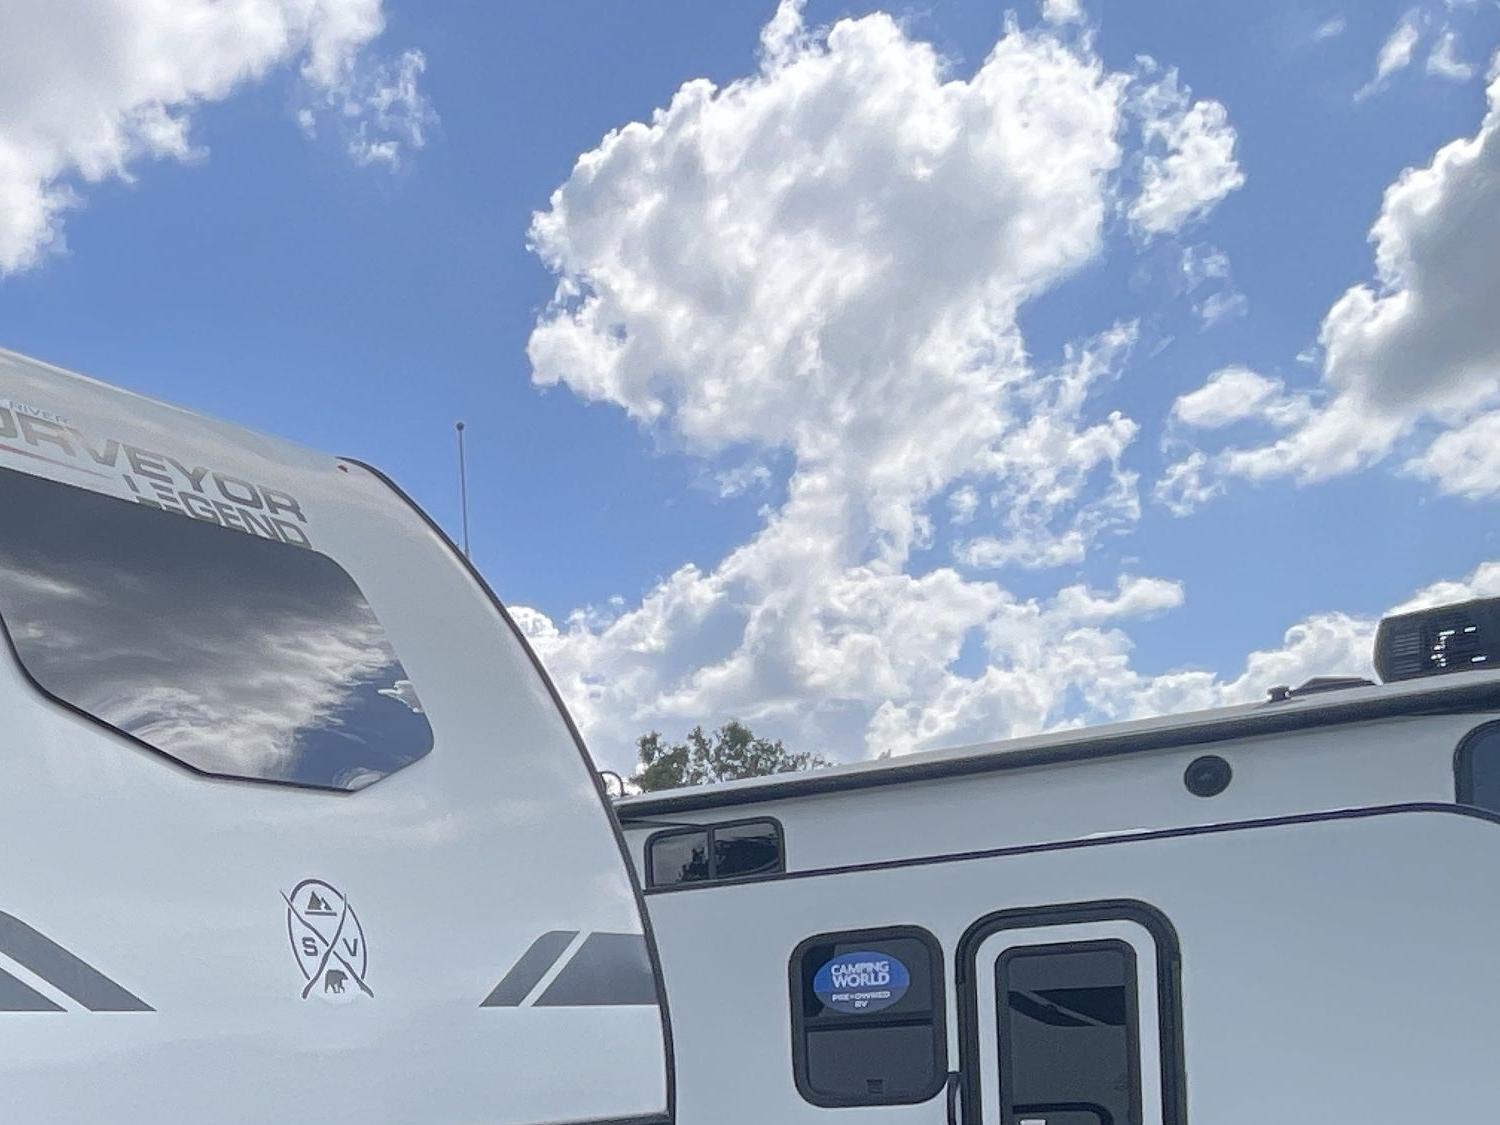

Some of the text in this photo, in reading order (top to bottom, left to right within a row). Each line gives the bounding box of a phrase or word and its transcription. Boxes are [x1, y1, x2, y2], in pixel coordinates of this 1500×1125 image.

[122, 474, 312, 550] LEGEND
[830, 960, 890, 976] CAMPING
[831, 972, 890, 988] WORLD
